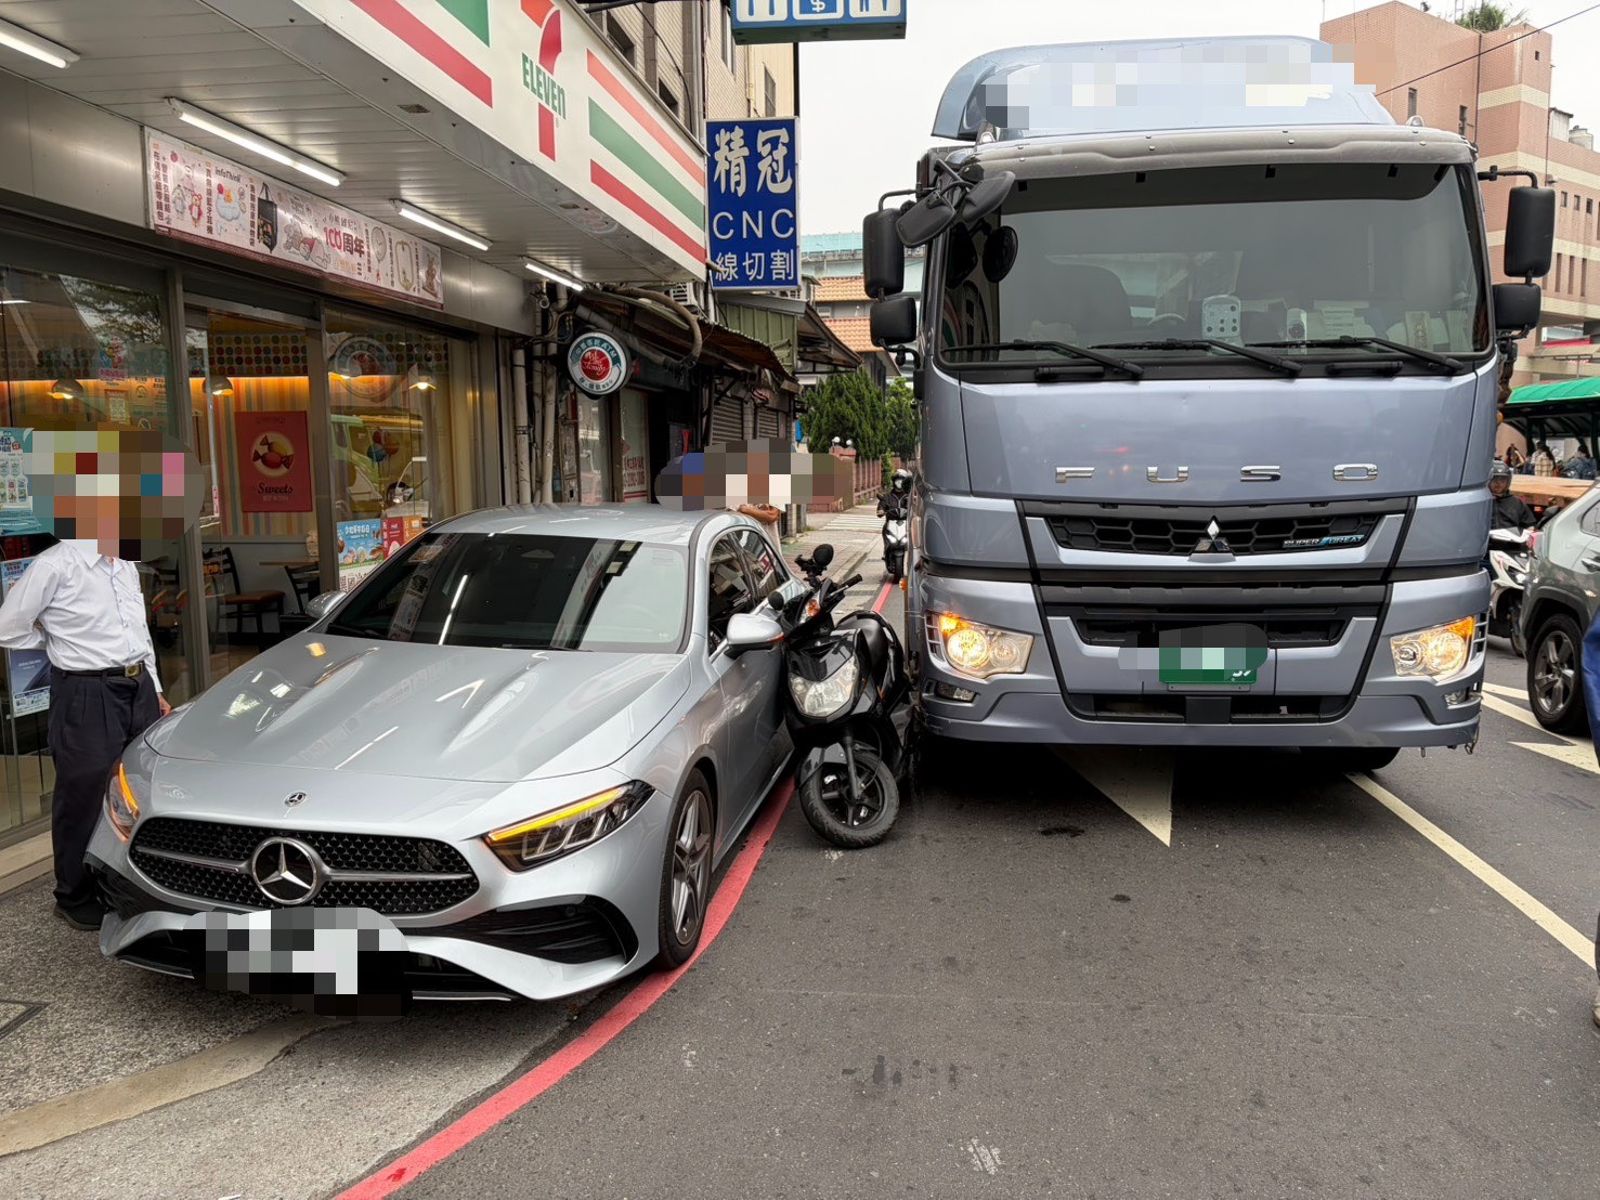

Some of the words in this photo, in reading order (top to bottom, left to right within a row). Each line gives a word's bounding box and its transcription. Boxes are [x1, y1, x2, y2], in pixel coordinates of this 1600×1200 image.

[714, 125, 794, 197] 精冠
[712, 208, 795, 239] CNC
[714, 249, 794, 283] 線切割
[1055, 463, 1379, 483] FUSO
[257, 481, 293, 495] Sweets
[1282, 538, 1320, 549] SUPER
